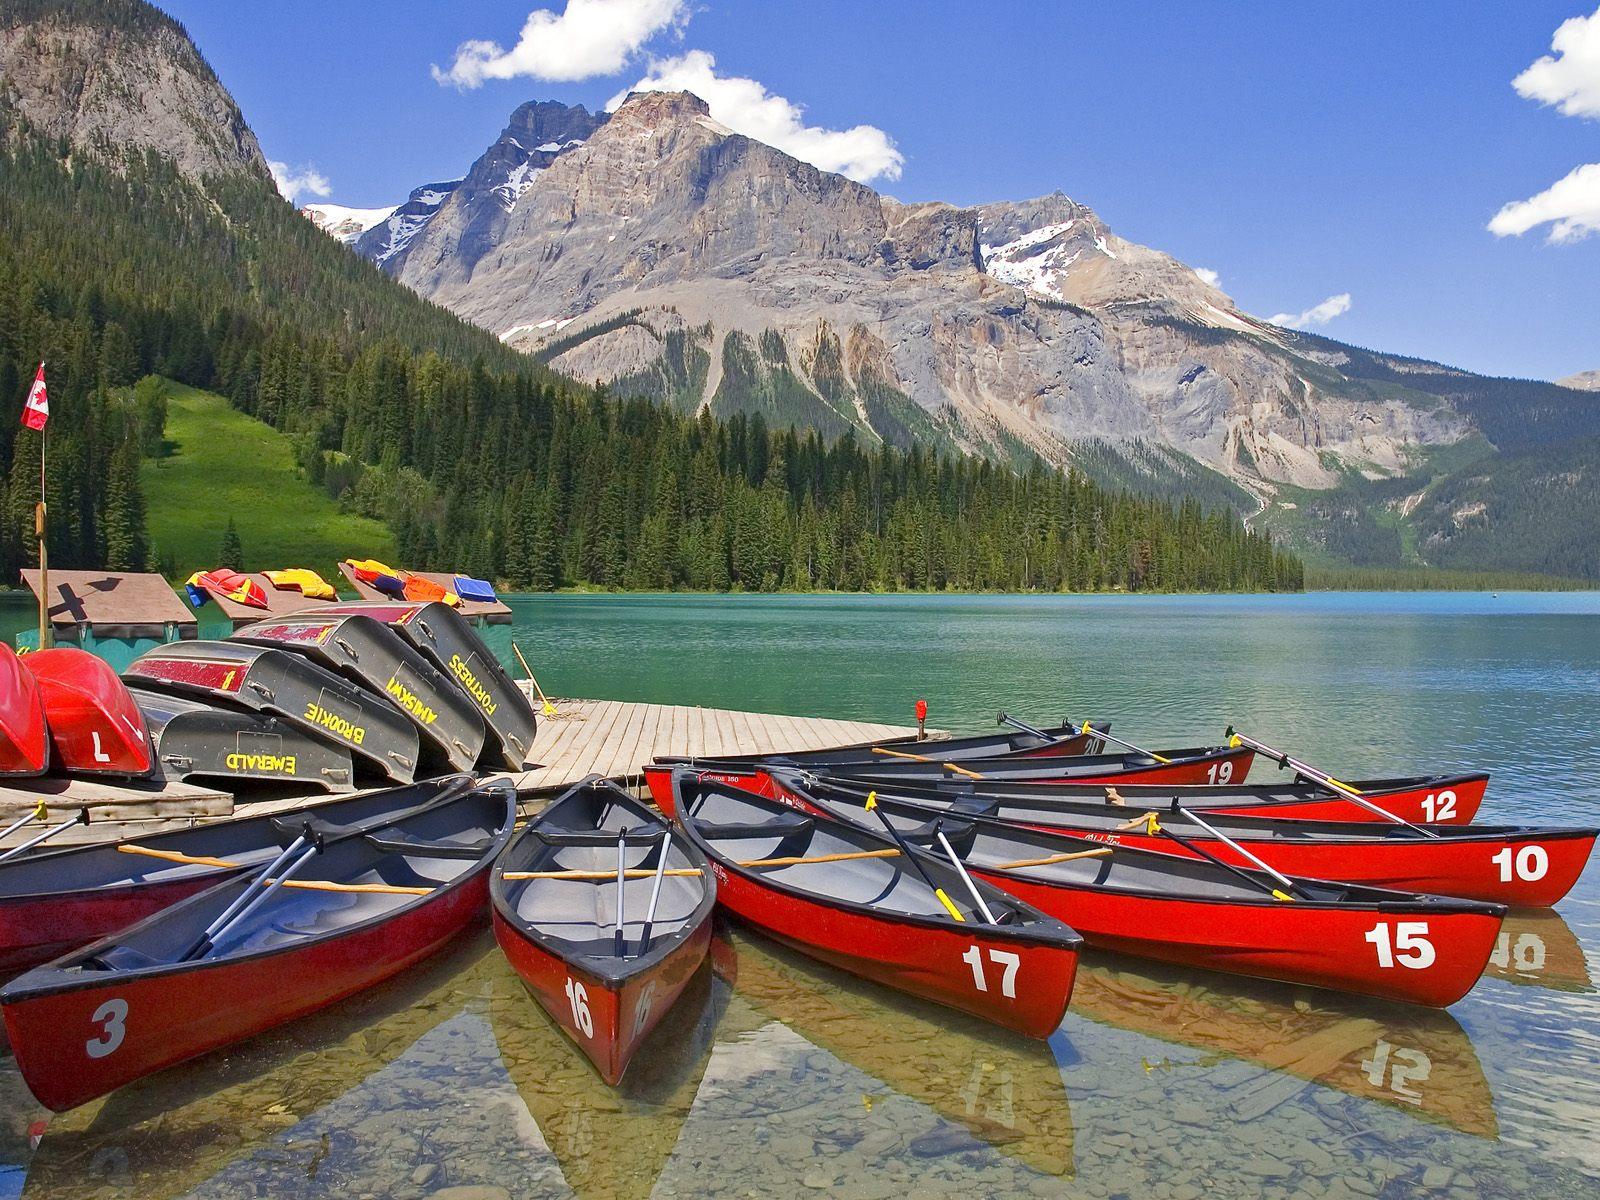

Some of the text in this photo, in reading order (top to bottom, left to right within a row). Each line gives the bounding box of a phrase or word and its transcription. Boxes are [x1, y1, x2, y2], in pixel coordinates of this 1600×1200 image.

[385, 677, 437, 724] AMISKWI
[448, 654, 497, 716] FORTRESS
[303, 702, 365, 744] BROOKIE
[226, 753, 296, 775] EMERALD
[1084, 738, 1100, 755] 20
[1207, 761, 1234, 785] 19
[1420, 790, 1457, 823] 12
[1491, 845, 1549, 882] 10
[1364, 921, 1436, 970] 15
[962, 944, 1021, 999] 17
[86, 998, 129, 1058] 3
[564, 976, 594, 1040] 16
